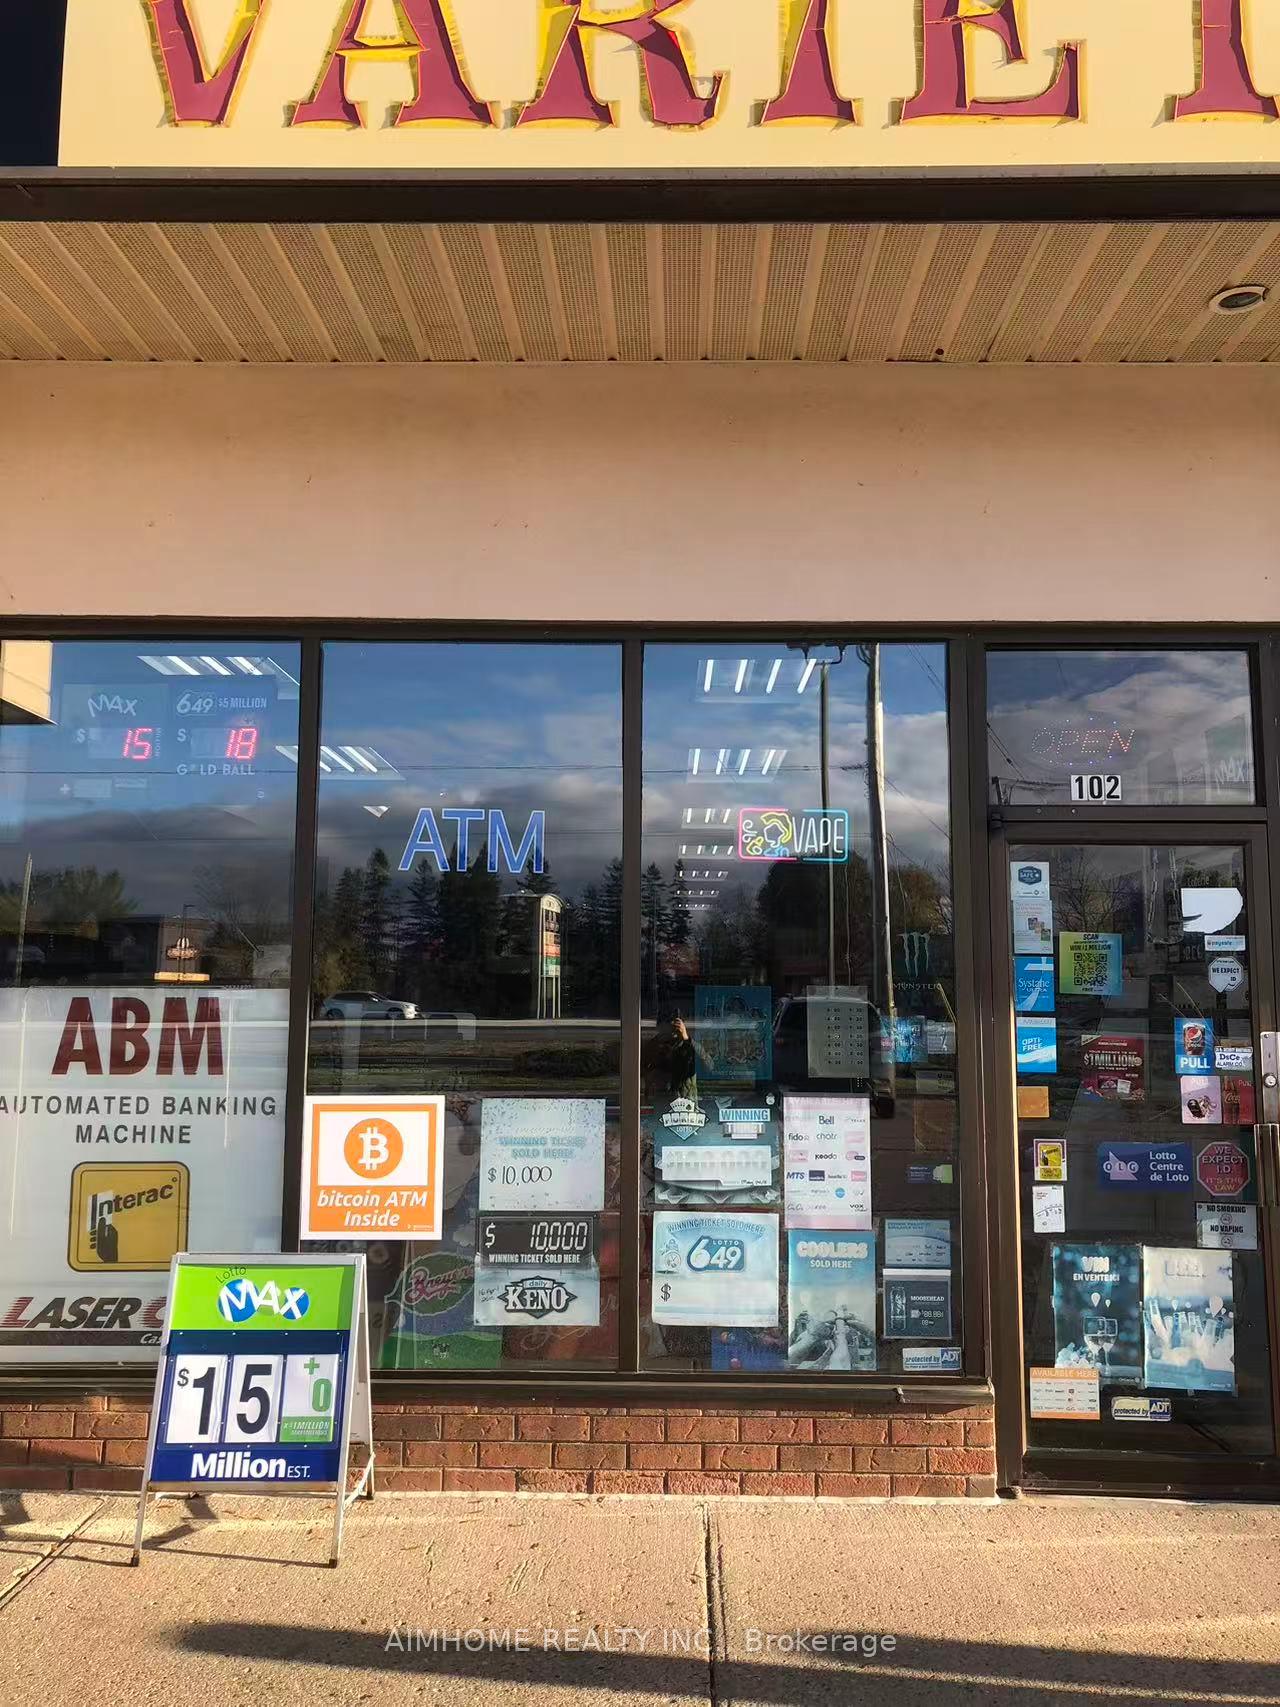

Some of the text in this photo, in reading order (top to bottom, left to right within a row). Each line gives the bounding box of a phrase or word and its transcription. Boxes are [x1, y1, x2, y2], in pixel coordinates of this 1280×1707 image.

[177, 692, 214, 714] 649
[230, 697, 267, 709] MILLION
[122, 727, 153, 760] 15
[225, 727, 258, 760] 18
[1032, 727, 1136, 756] OPEN
[222, 763, 255, 776] BALL
[1074, 775, 1121, 800] 102
[398, 807, 545, 874] ATM
[793, 817, 845, 855] VAPE
[51, 996, 224, 1076] ABM
[1180, 1057, 1211, 1069] PULL
[0, 1095, 276, 1116] AUTOMATED BANKING
[721, 1110, 769, 1121] WINNING
[818, 1115, 835, 1125] Bell
[75, 1124, 192, 1144] MACHINE
[788, 1132, 804, 1141] fido
[1150, 1151, 1177, 1161] Lotto
[1214, 1146, 1232, 1154] WE
[1103, 1160, 1139, 1173] OLG
[1150, 1161, 1184, 1171] Centre
[1201, 1155, 1245, 1164] EXPECT
[487, 1167, 497, 1183] $
[786, 1171, 805, 1180] MTS
[1150, 1172, 1190, 1182] de Loto
[1214, 1184, 1235, 1192] LAW
[90, 1183, 174, 1231] Interac
[317, 1189, 428, 1208] bitcoin ATM
[1206, 1204, 1246, 1213] NO SMOKING
[344, 1209, 400, 1227] Inside
[667, 1219, 699, 1232] WINNING
[484, 1221, 588, 1253] $ 10,000
[1210, 1224, 1244, 1233] NO VAPING
[489, 1253, 580, 1264] WINNING TICKET SOLD HERE
[689, 1238, 742, 1270] 649
[797, 1240, 868, 1259] COOLERS
[810, 1259, 853, 1269] SOLD HERE
[216, 1265, 247, 1284] Lotto
[528, 1280, 548, 1288] daily
[660, 1282, 671, 1302] $
[219, 1278, 305, 1323] MAX
[504, 1285, 570, 1311] KENO
[1, 1296, 142, 1330] LASER
[905, 1350, 960, 1364] protected by ADT
[1076, 1370, 1097, 1378] HERE
[312, 1377, 333, 1413] 0
[1114, 1401, 1170, 1419] protected by ADT
[191, 1451, 311, 1479] Million EST.
